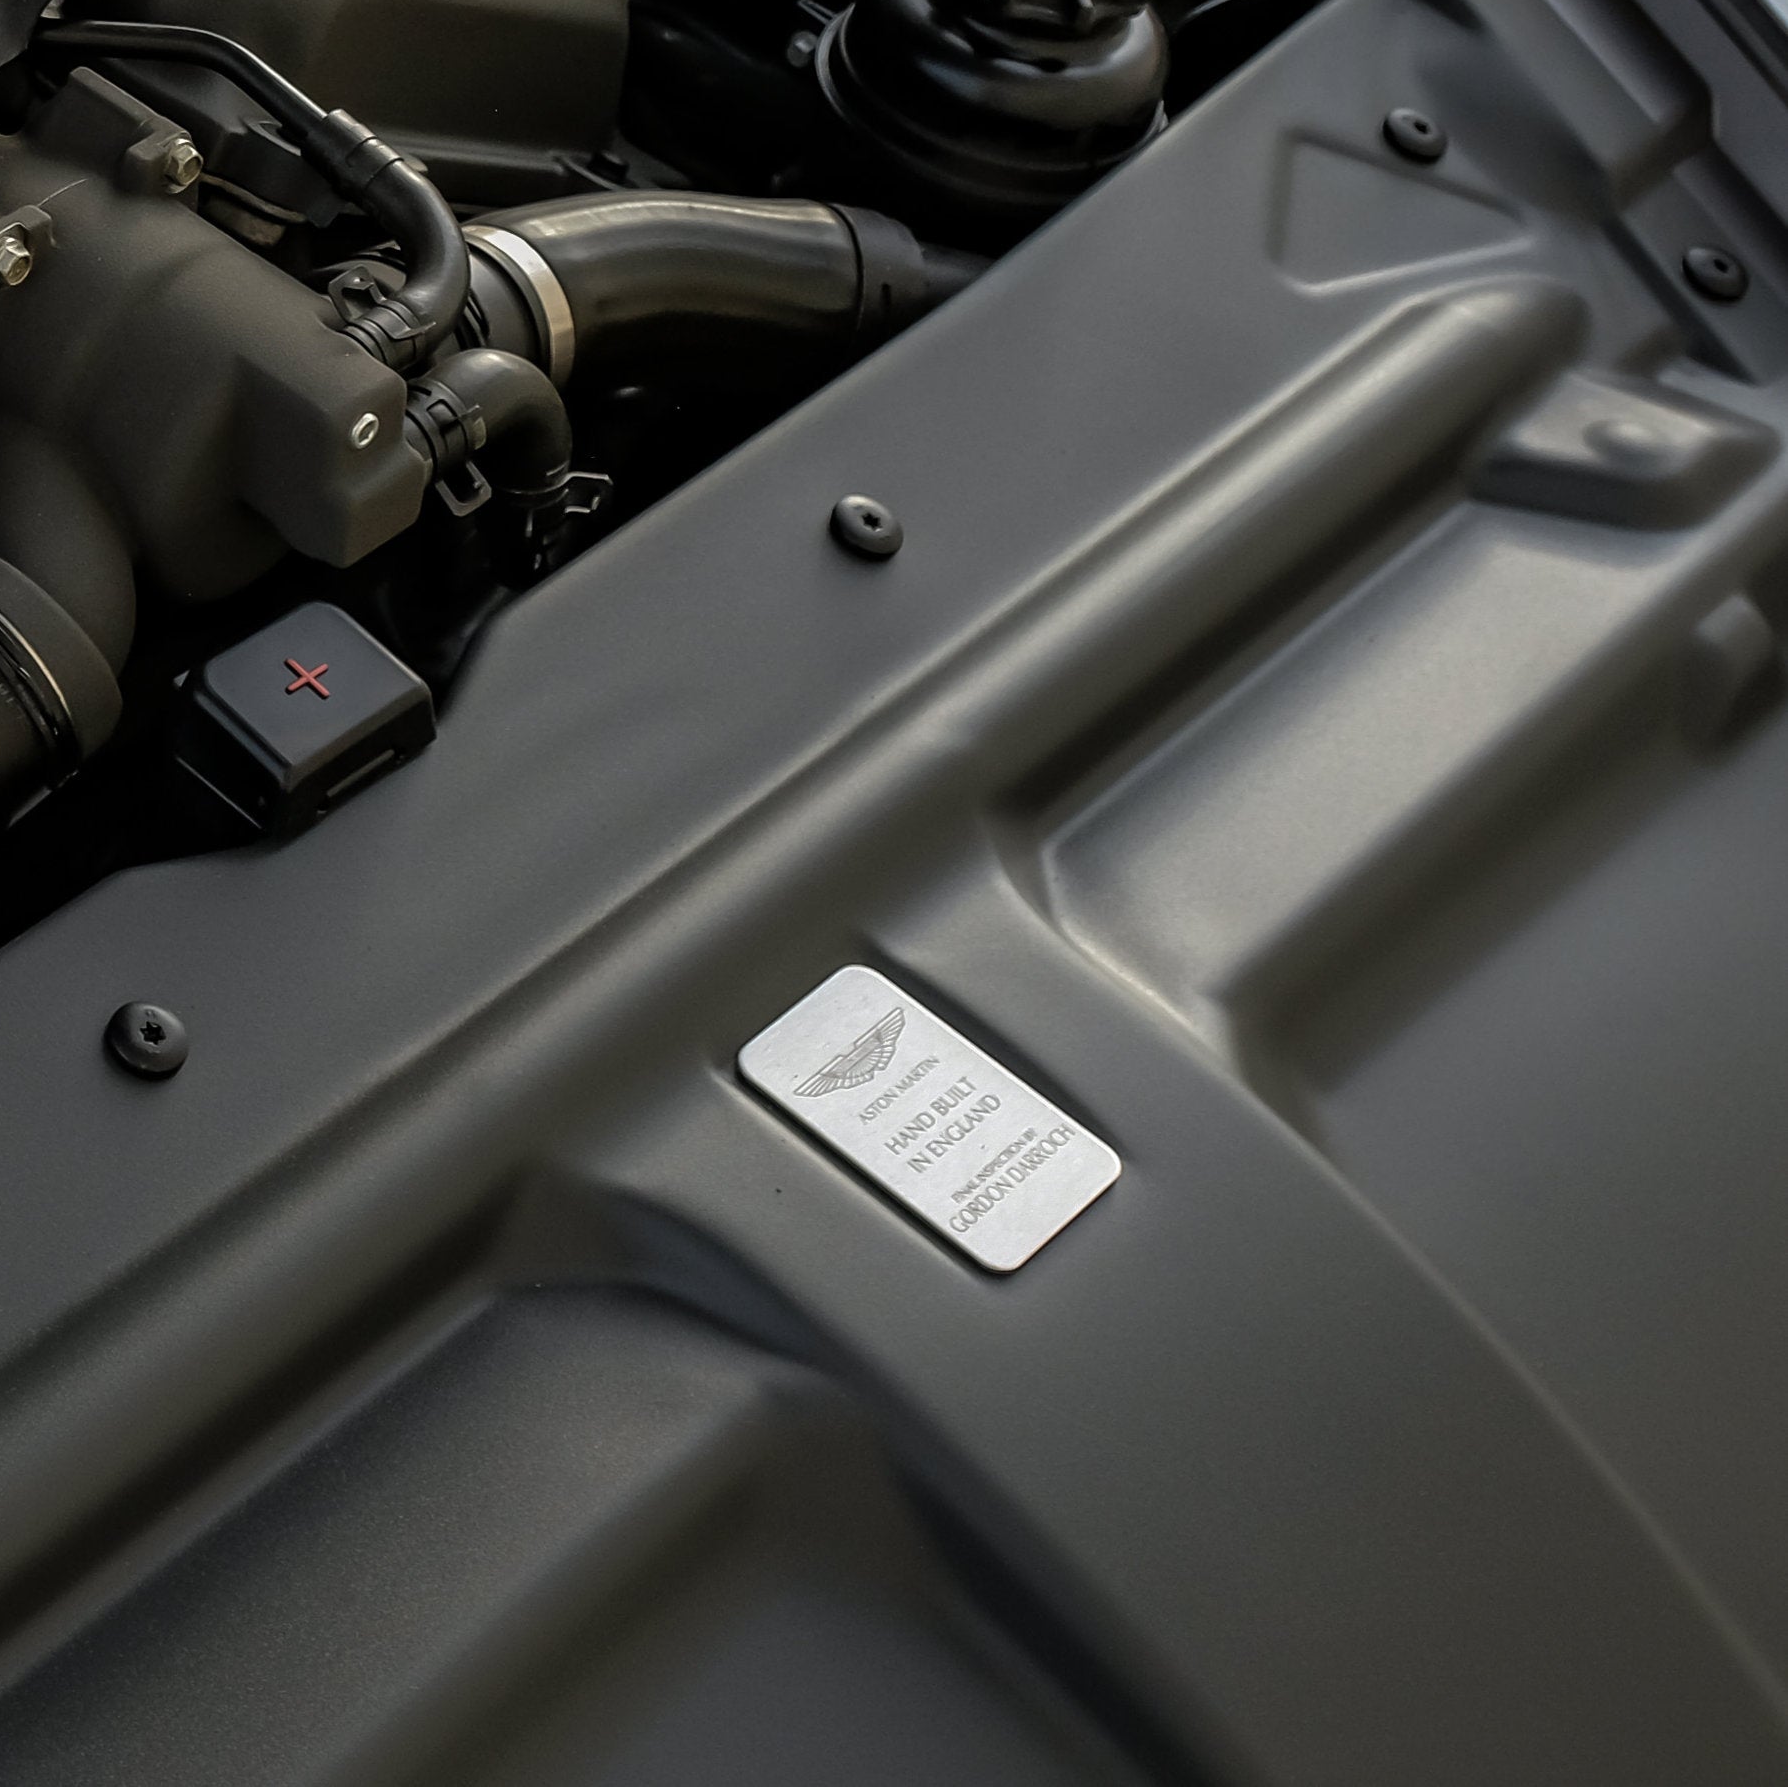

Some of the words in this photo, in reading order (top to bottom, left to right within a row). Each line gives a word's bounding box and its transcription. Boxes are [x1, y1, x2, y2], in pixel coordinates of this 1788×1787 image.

[884, 1111, 936, 1155] HAND
[930, 1076, 976, 1116] BUILT
[906, 1152, 933, 1173] IN
[925, 1094, 1001, 1158] ENGLAND
[949, 1175, 1015, 1233] GORDON
[1006, 1123, 1076, 1183] DARROCH
